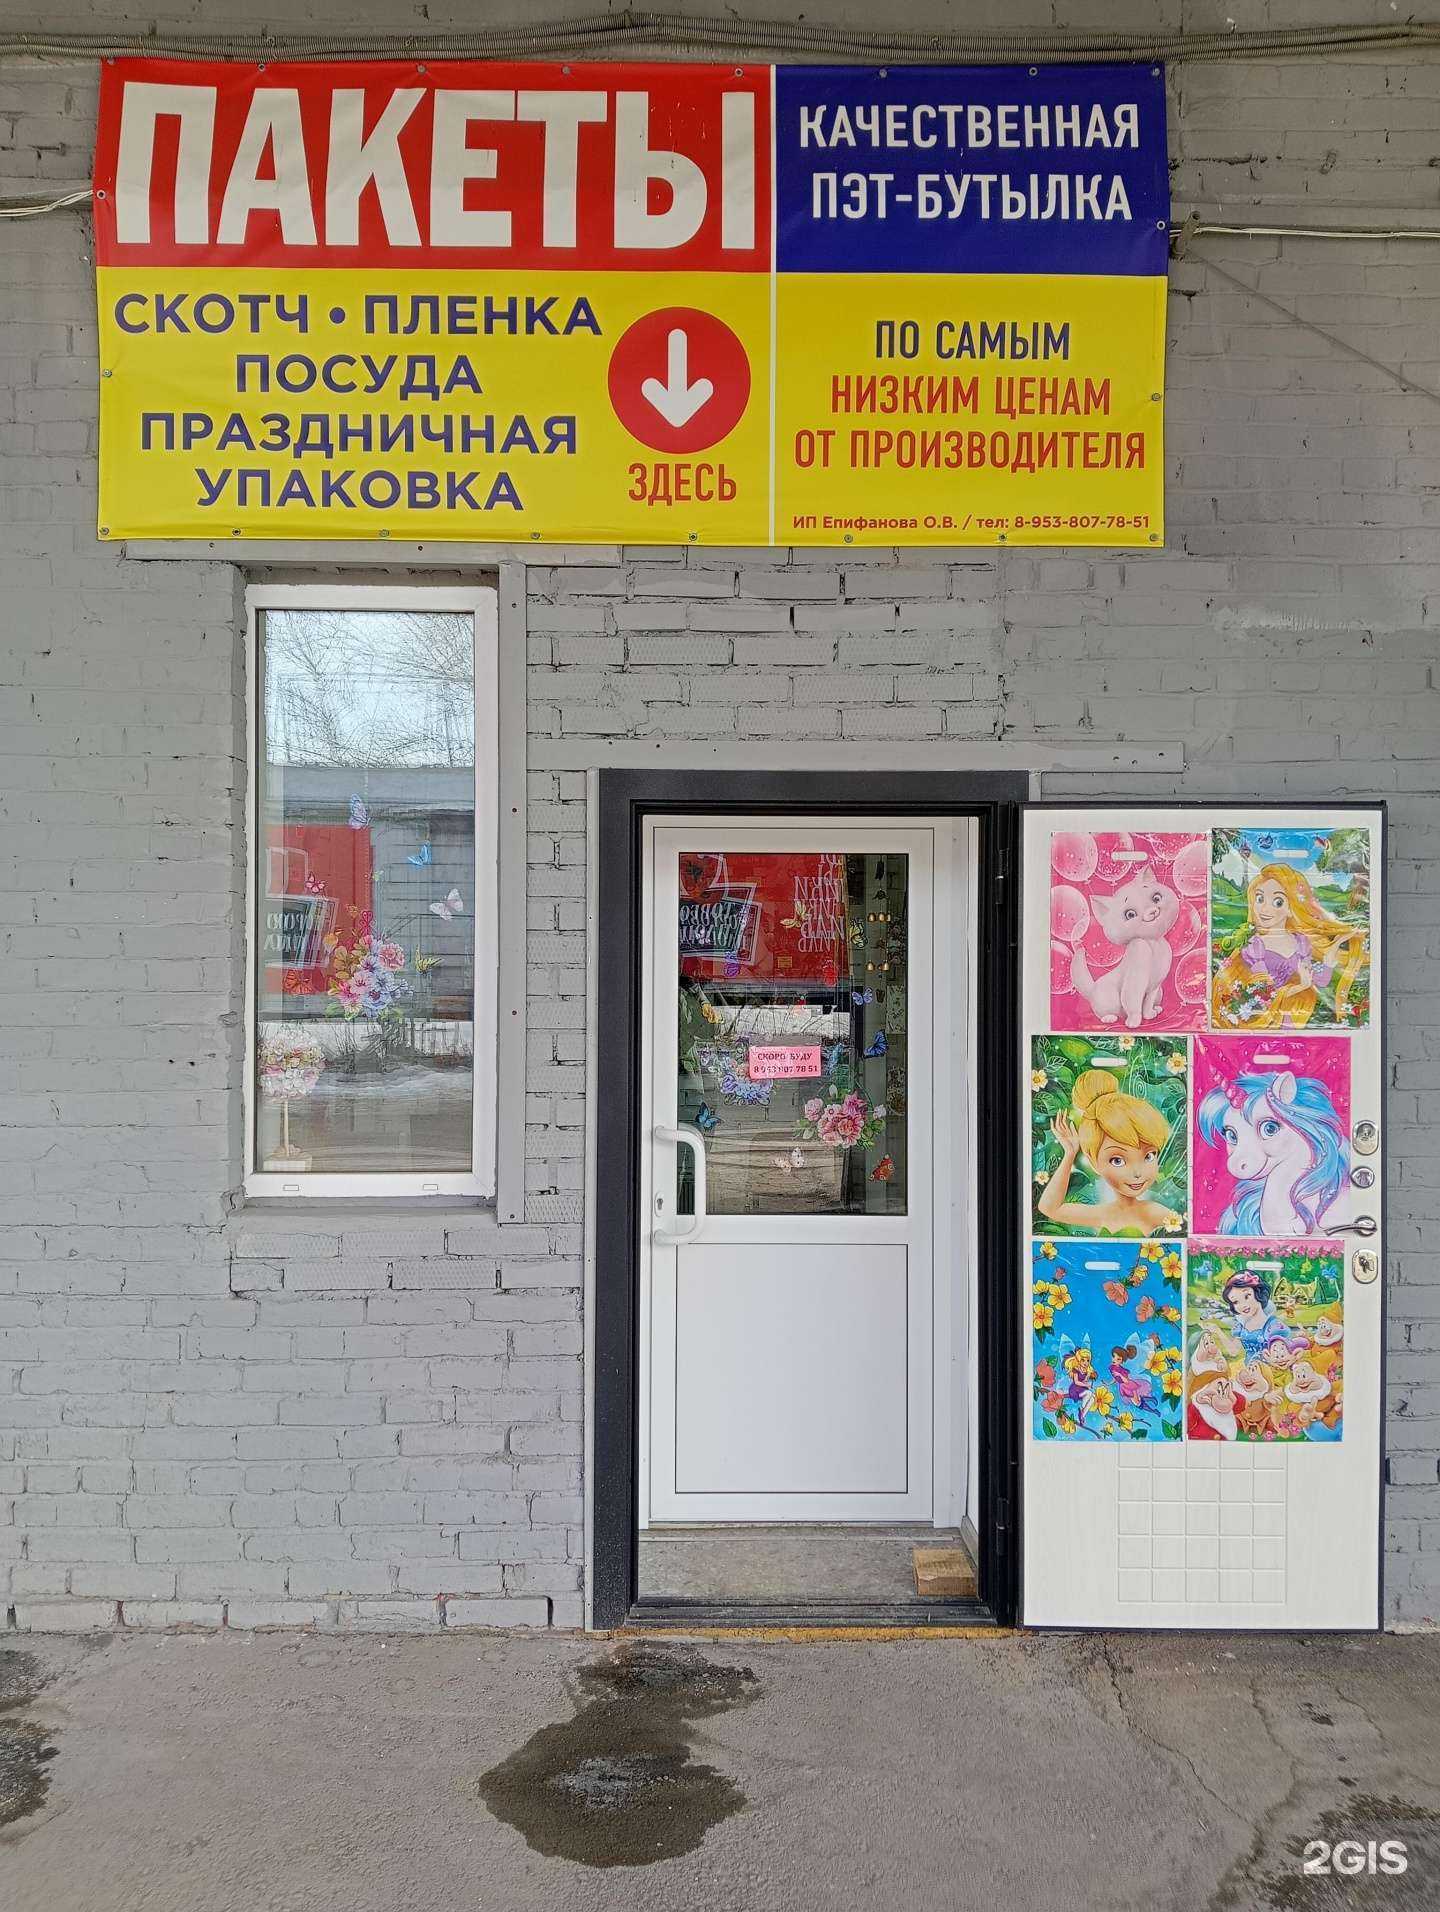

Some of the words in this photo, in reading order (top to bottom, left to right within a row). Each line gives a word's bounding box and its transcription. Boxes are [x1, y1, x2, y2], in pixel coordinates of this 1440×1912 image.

[799, 103, 1140, 149] КАЧЕСТВЕННАЯ
[115, 81, 755, 250] ПАКЕТЫ
[811, 171, 1134, 222] ПЭТ-БУТЫЛКА
[113, 292, 309, 335] СКОТЧ
[364, 294, 603, 337] ПЛЕНКА
[875, 320, 920, 360] ПО
[936, 321, 1071, 361] САМЫМ
[236, 353, 483, 401] ПОСУДА
[831, 374, 980, 415] НИЗКИМ
[994, 376, 1111, 420] ЦЕНАМ
[140, 411, 578, 459] ПРАЗДНИЧНАЯ
[794, 429, 836, 469] ОТ
[849, 429, 1146, 474] ПРОИЗВОДИТЕЛЯ
[194, 467, 524, 511] УПАКОВКА
[627, 462, 737, 506] ЗДЕСЬ
[792, 515, 817, 529] ИП
[822, 514, 918, 531] Епифанова
[923, 515, 958, 529] О.В.
[976, 517, 1009, 529] тел:
[1014, 515, 1150, 529] 8-953-807-78-51
[757, 1053, 786, 1061] СКОРО
[790, 1053, 813, 1061] БУДУ
[796, 1065, 807, 1073] 78
